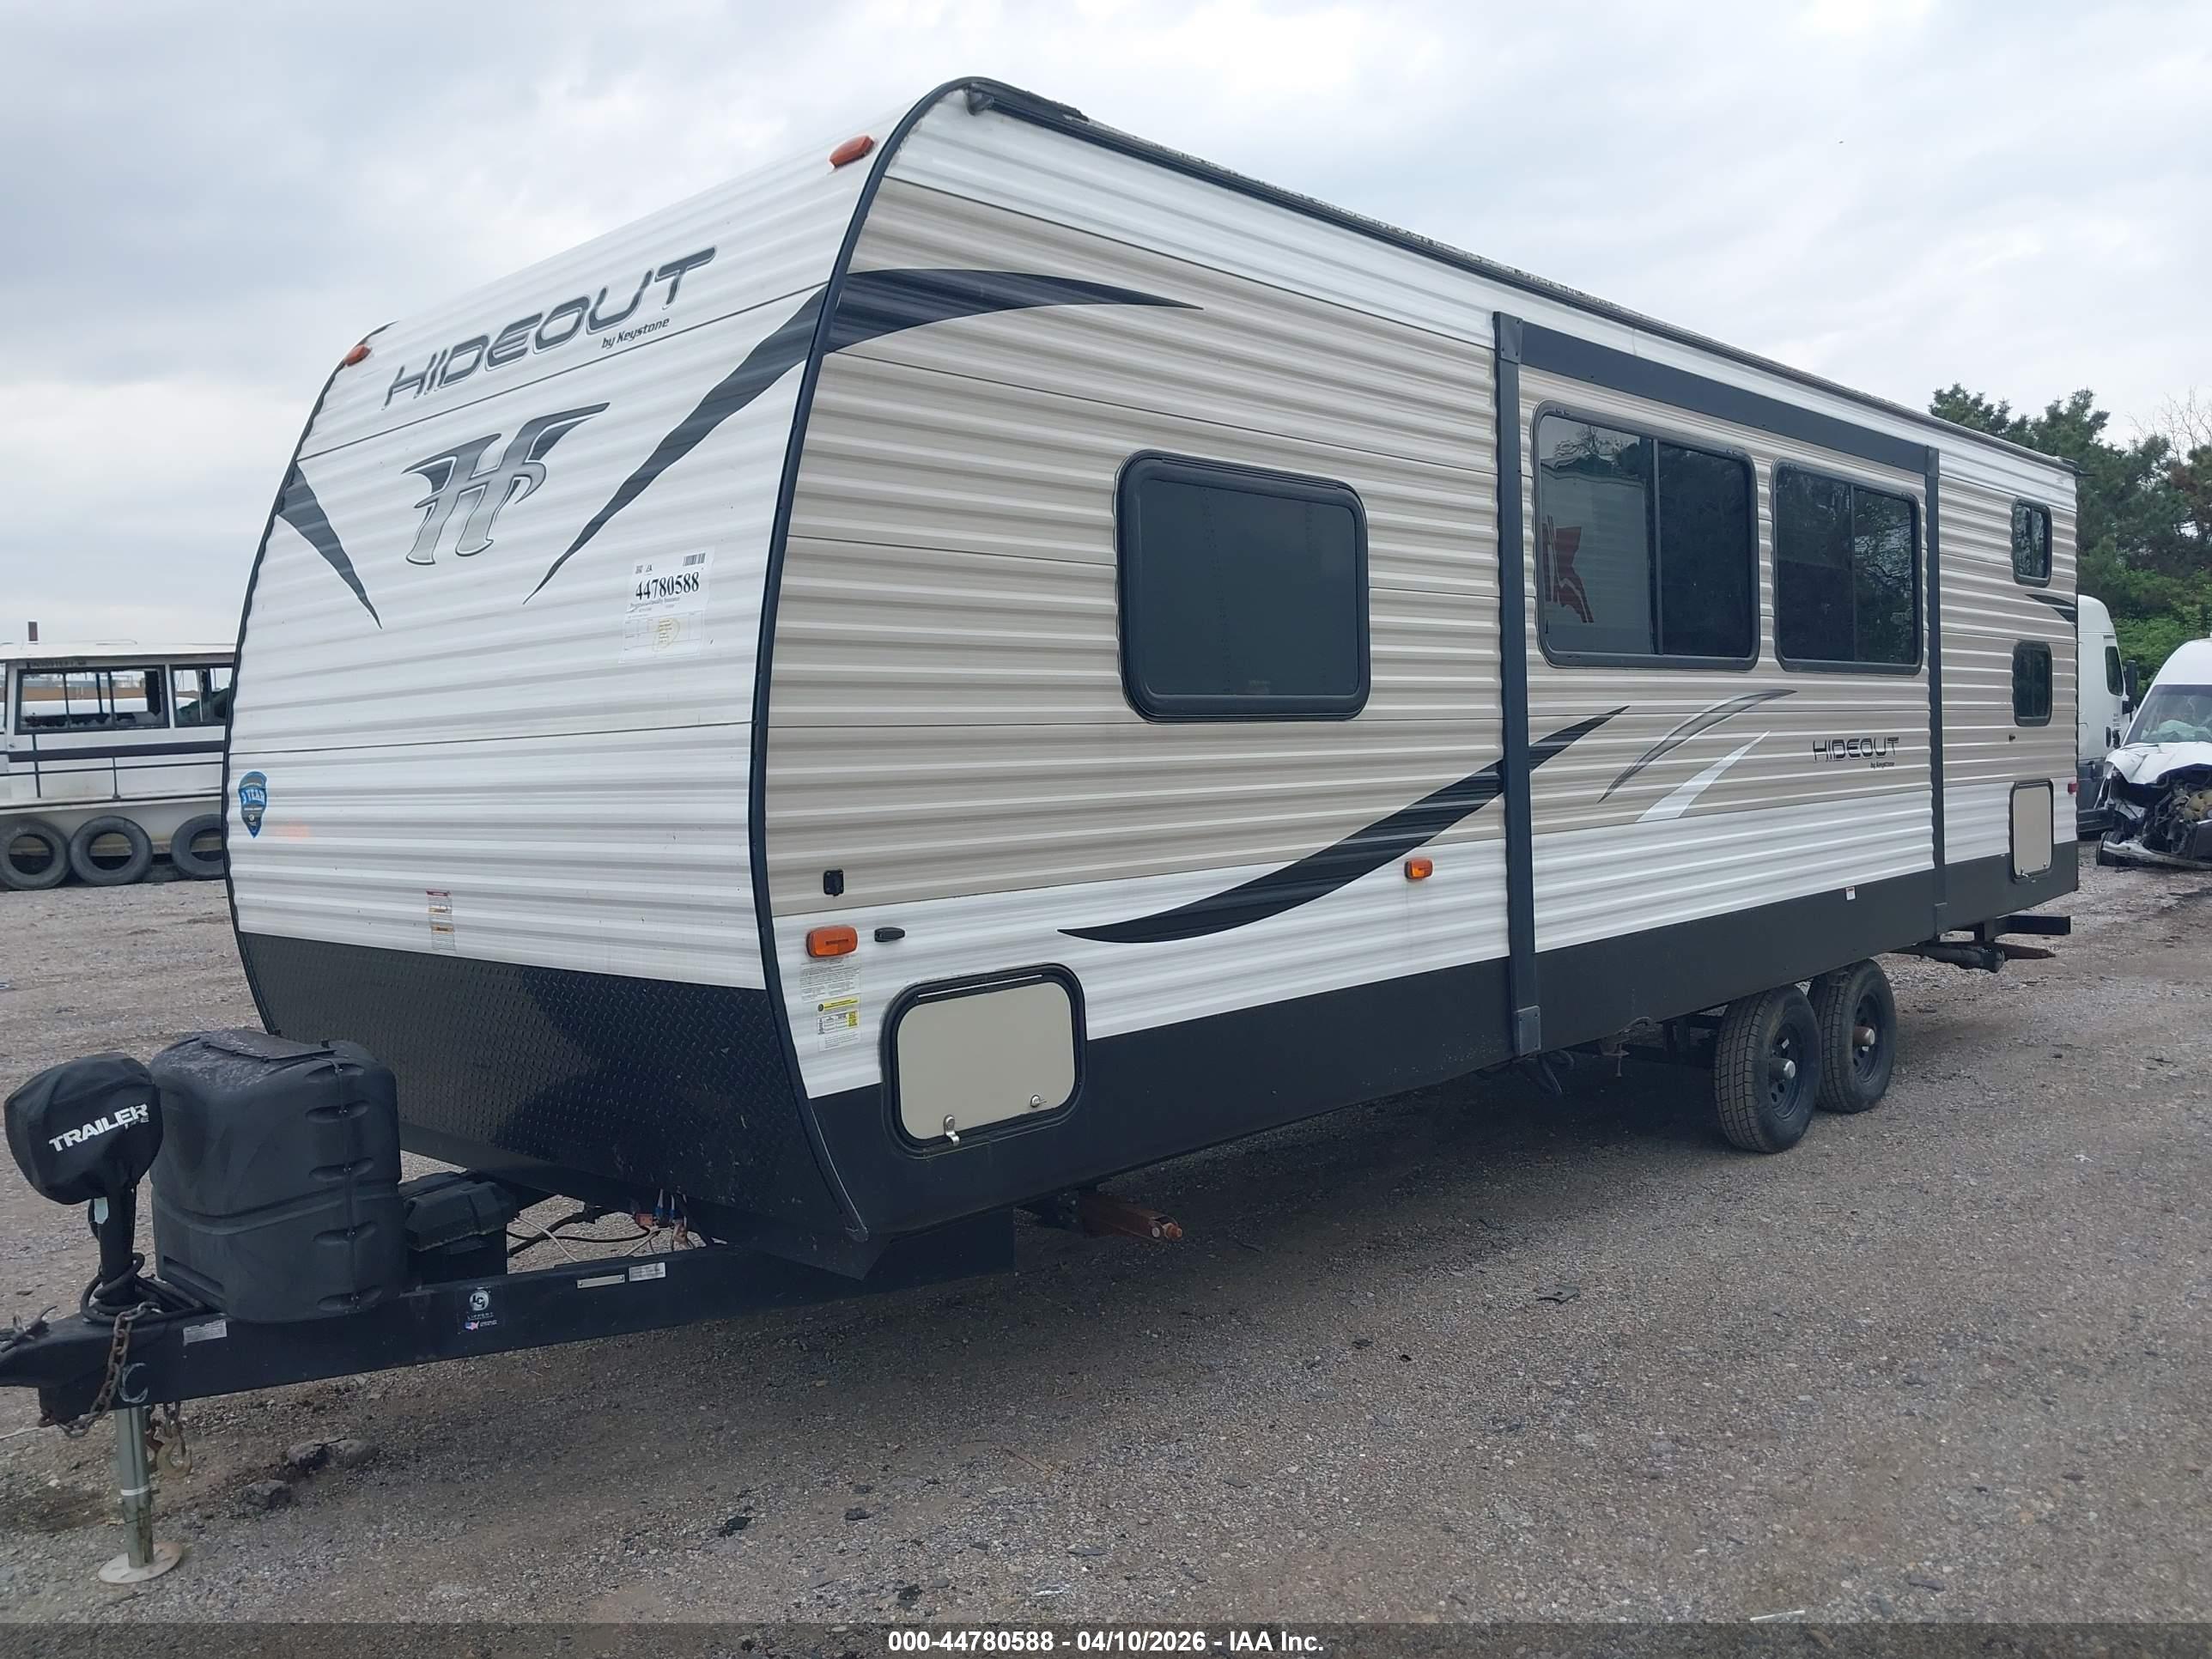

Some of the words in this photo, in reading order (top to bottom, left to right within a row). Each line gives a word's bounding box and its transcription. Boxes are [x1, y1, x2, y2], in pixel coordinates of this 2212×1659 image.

[381, 246, 717, 410] HIDEOUT
[602, 337, 616, 349] by
[617, 318, 670, 343] Keystone
[635, 571, 700, 601] 44780588
[1813, 736, 1899, 763] HIDEOUT
[48, 1103, 149, 1152] TRAILER
